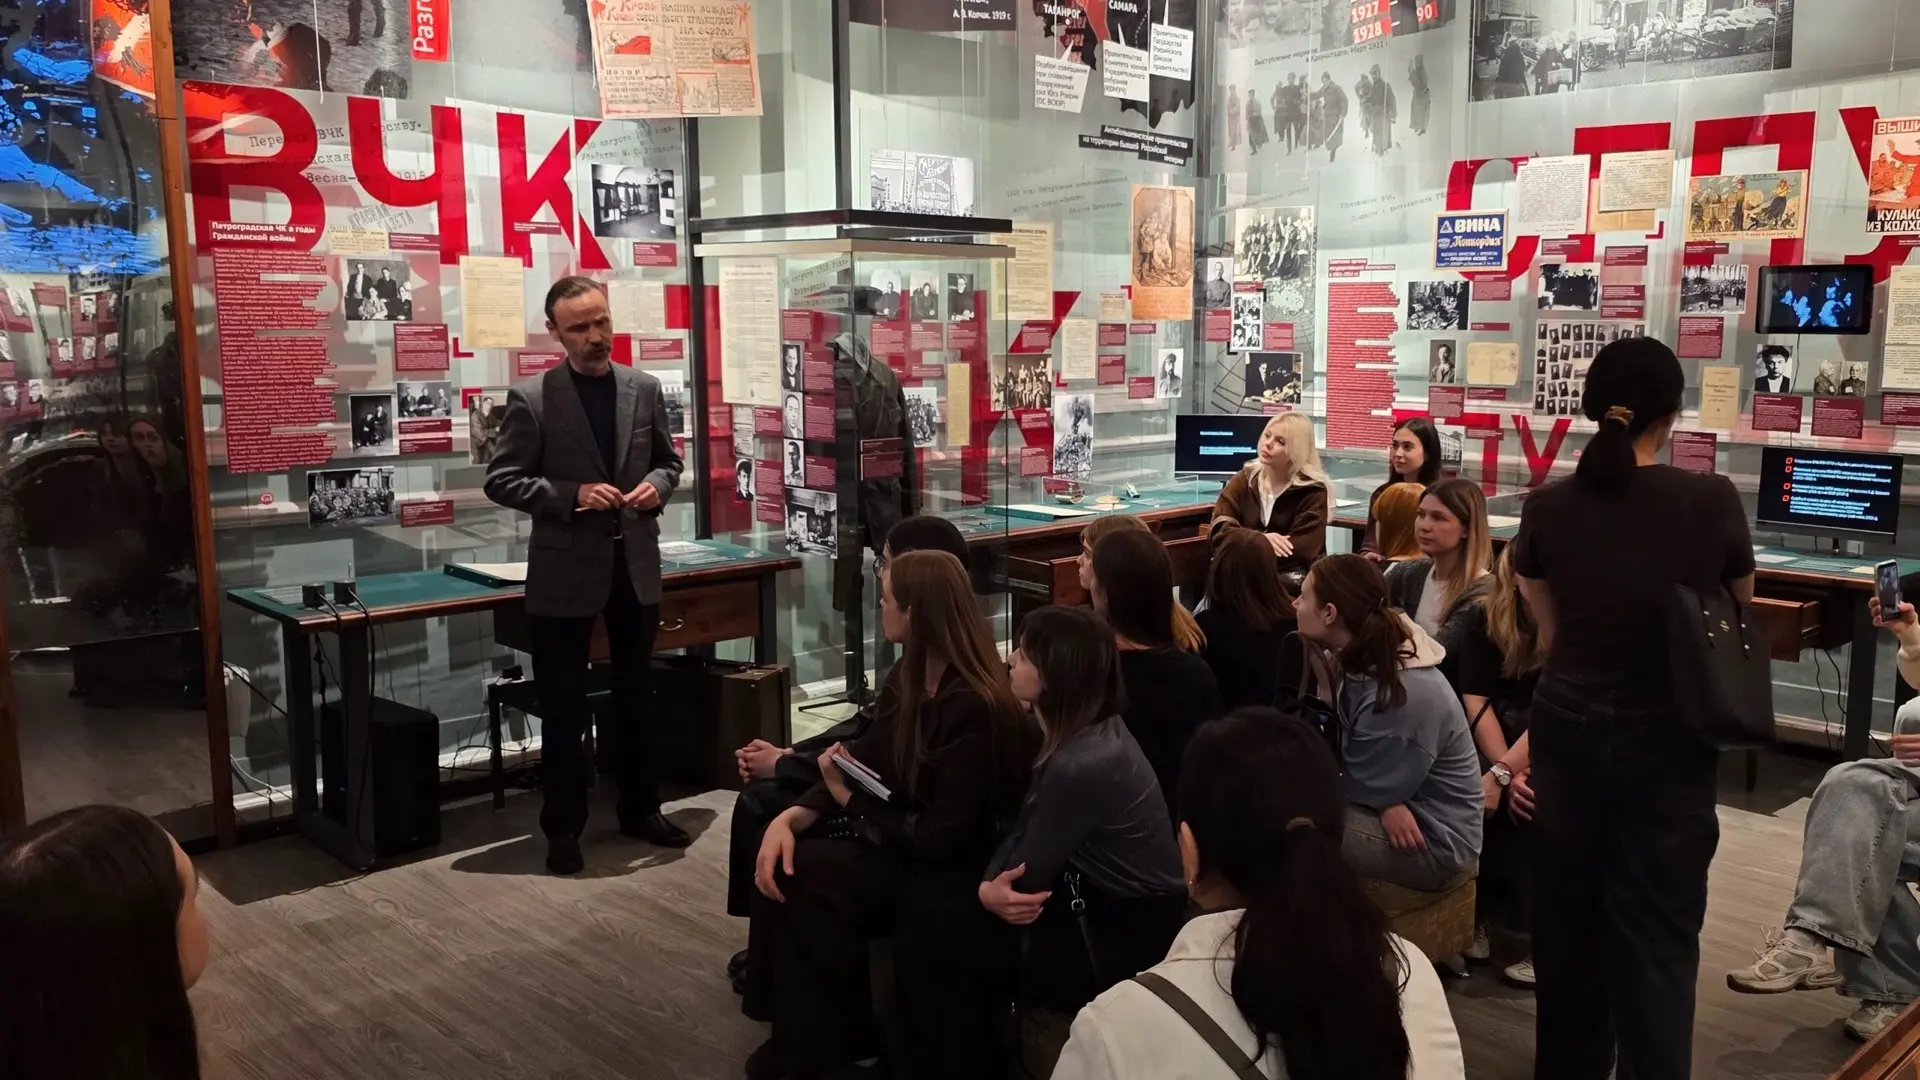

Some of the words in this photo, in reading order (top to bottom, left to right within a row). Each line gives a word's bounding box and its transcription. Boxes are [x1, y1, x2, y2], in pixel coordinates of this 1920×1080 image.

[1043, 4, 1081, 19] ТАГАНРОГ
[1109, 0, 1138, 14] САМАРА
[1351, 3, 1380, 23] 1927
[1416, 4, 1433, 23] 90
[1353, 20, 1382, 44] 1928
[318, 127, 345, 140] ВЧК
[1454, 217, 1501, 233] ВИНА
[1866, 219, 1882, 232] ИЗ
[212, 232, 268, 241] Гражданской
[269, 235, 296, 243] войны
